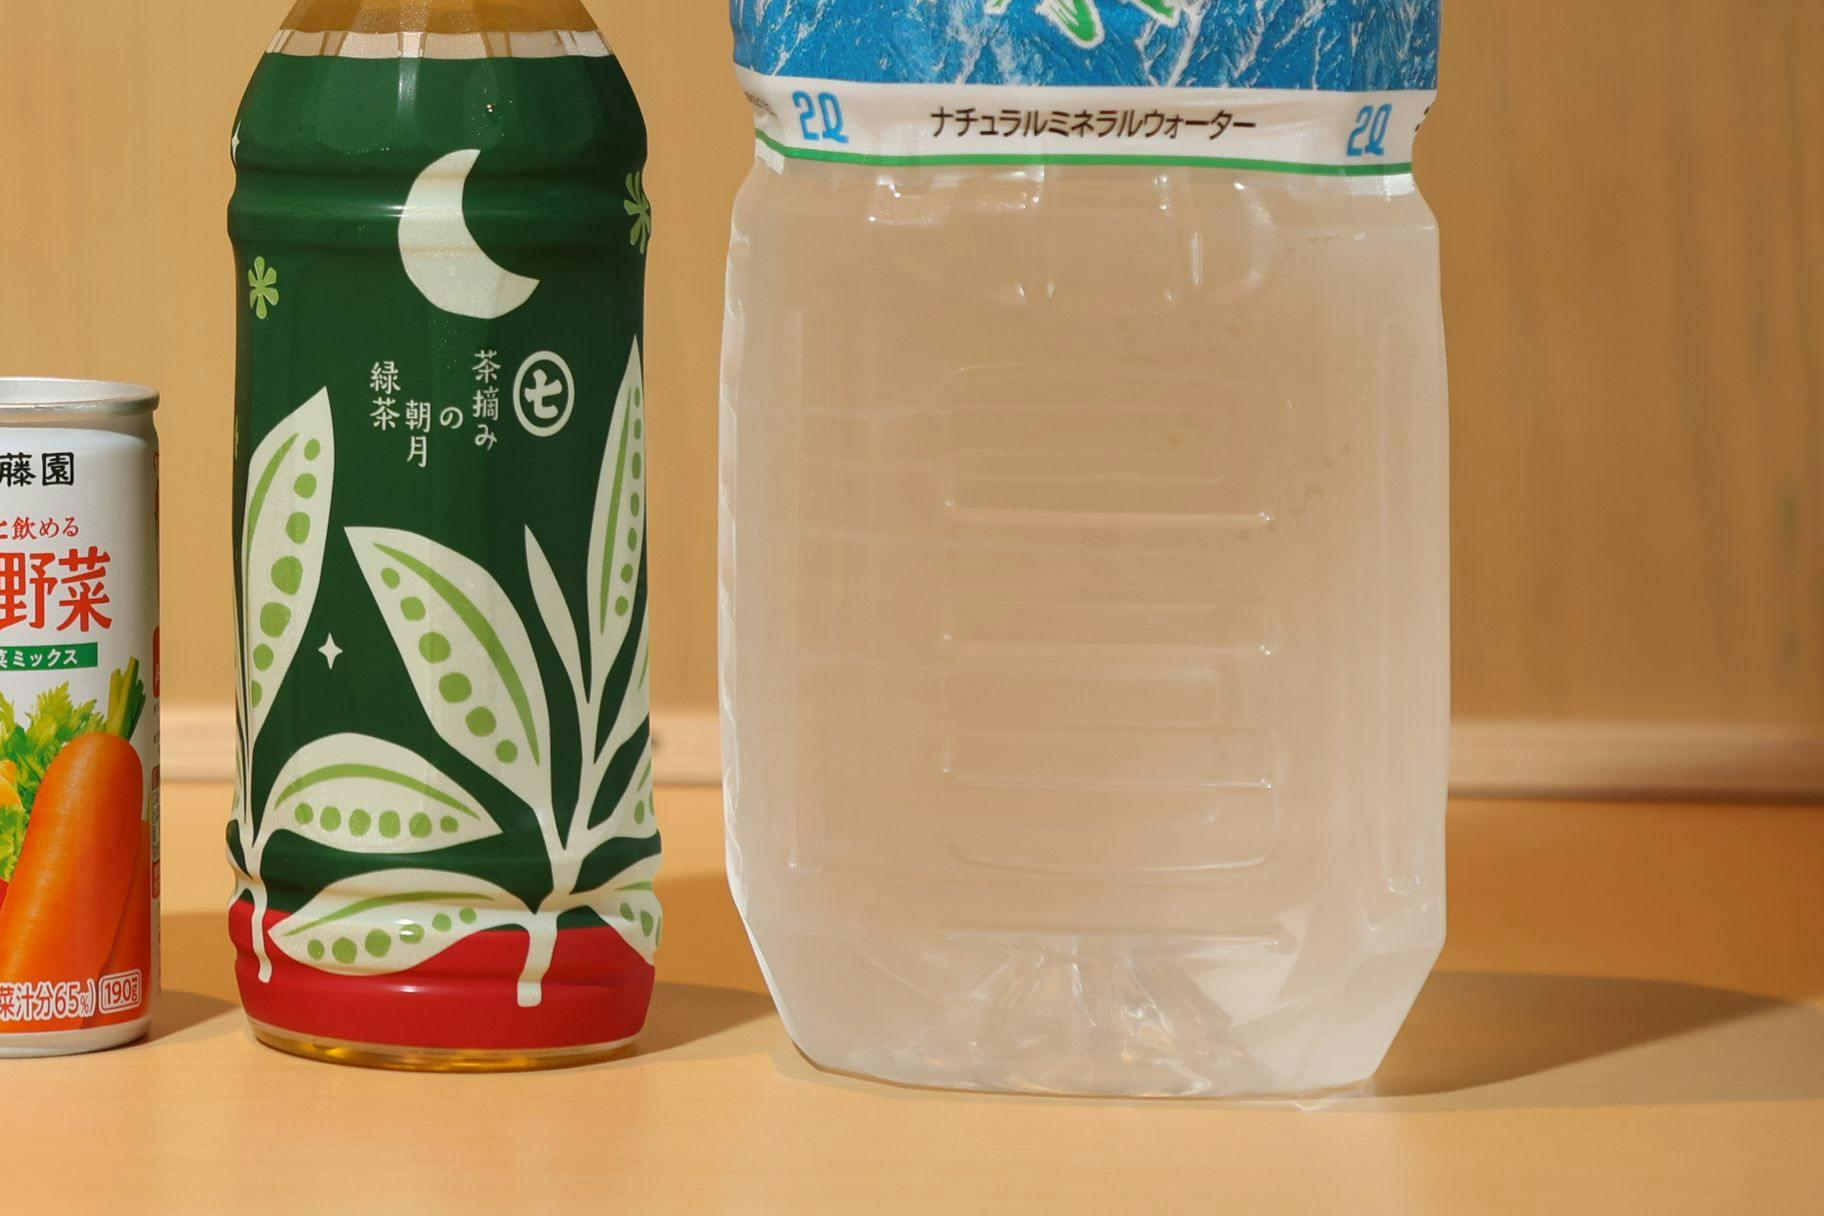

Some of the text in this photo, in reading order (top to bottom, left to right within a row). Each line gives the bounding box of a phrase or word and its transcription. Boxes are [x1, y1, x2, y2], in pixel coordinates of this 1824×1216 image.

[930, 106, 1258, 140] ナチュラルミネラルウォーター
[370, 360, 401, 432] 緑茶
[439, 406, 464, 430] の
[472, 350, 501, 451] 茶摘み
[405, 399, 431, 468] 朝月
